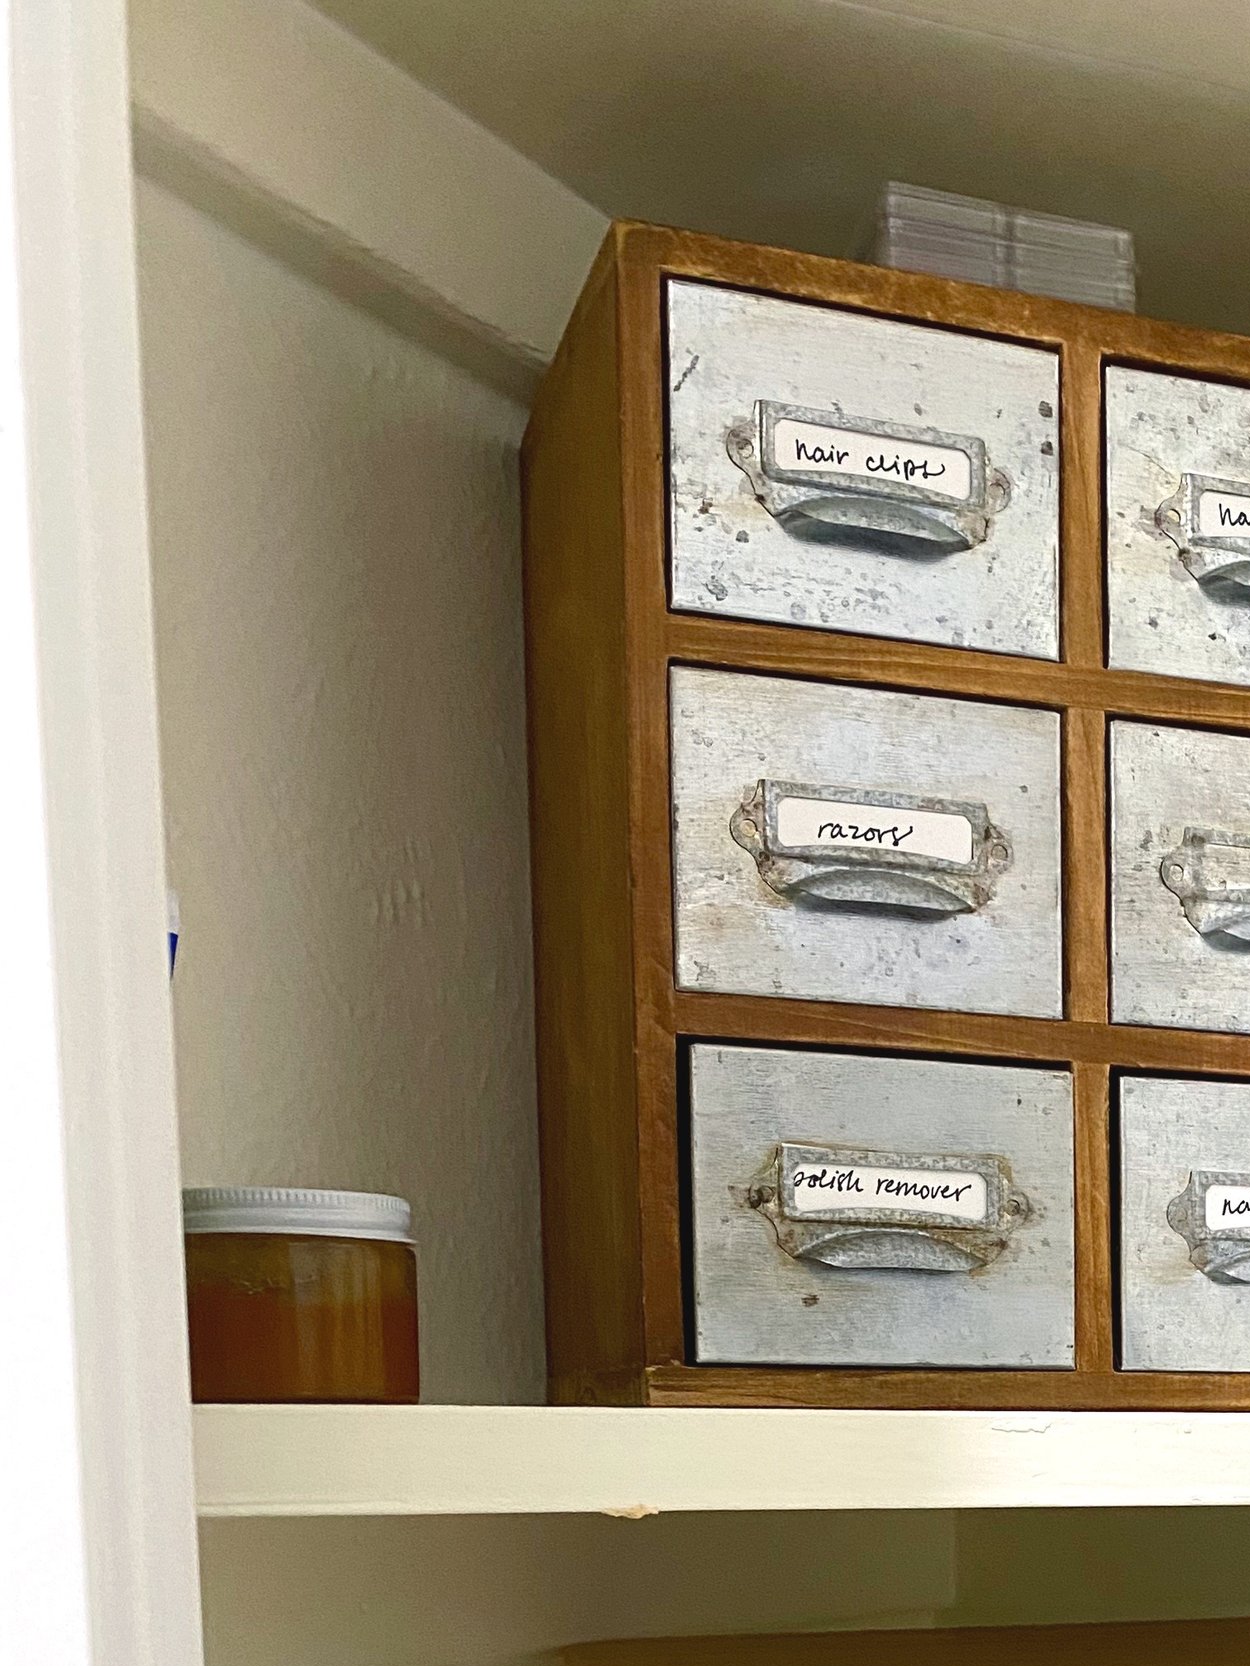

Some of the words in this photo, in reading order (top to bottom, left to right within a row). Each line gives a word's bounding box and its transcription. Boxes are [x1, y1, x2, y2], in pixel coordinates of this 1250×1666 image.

[795, 438, 850, 465] hair
[866, 454, 946, 481] clips
[817, 822, 914, 847] razors
[875, 1177, 972, 1202] remover
